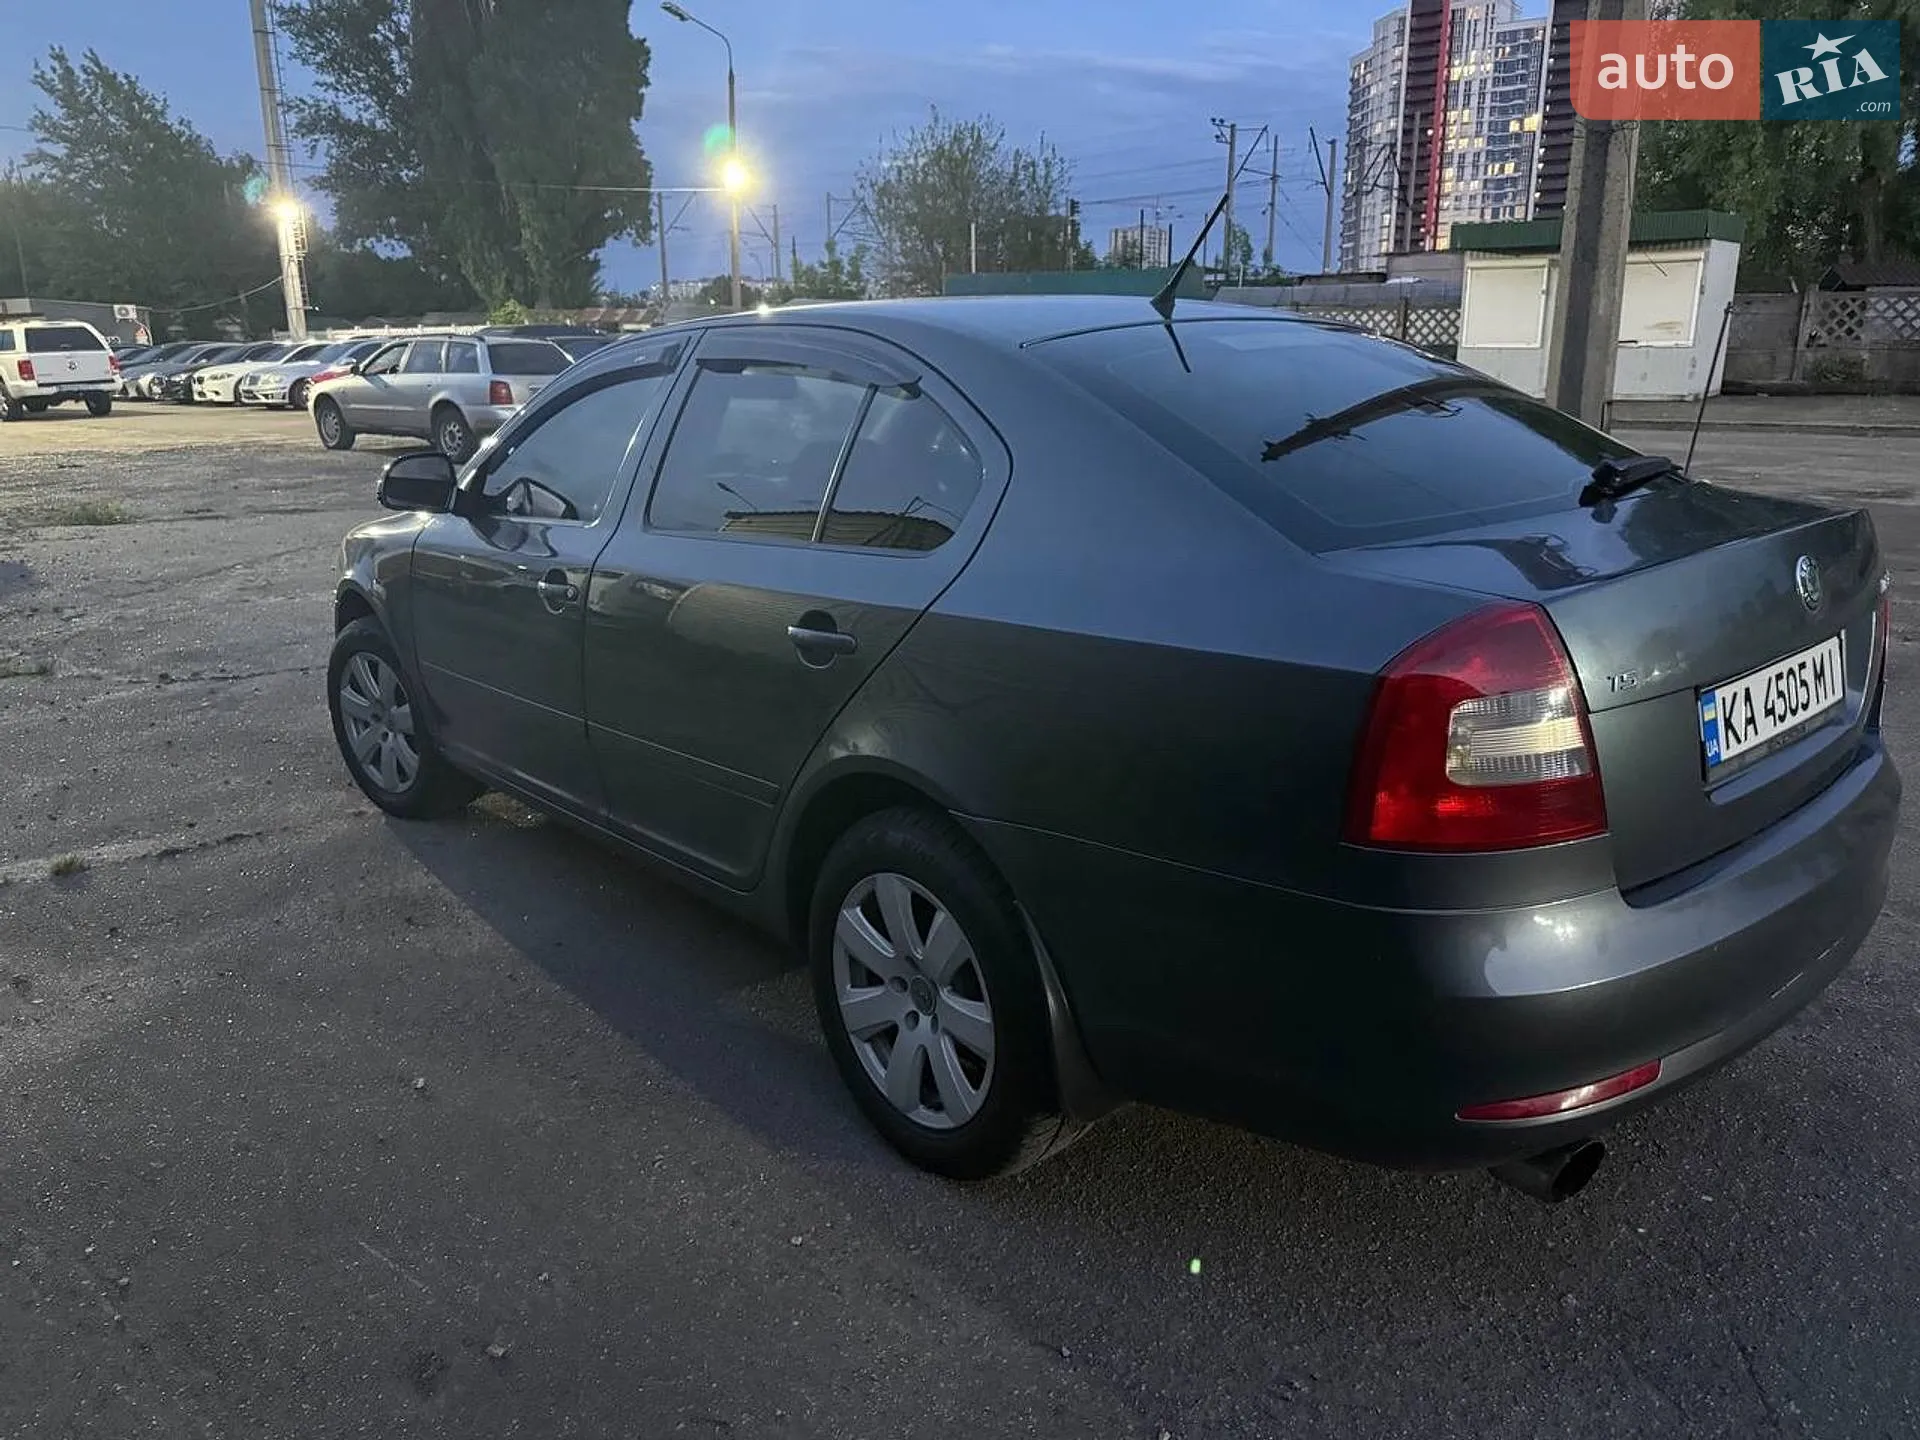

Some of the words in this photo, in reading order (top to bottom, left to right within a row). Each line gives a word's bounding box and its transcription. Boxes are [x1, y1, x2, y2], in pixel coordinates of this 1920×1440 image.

[1722, 686, 1758, 750] KA
[1763, 661, 1810, 728] 4505
[1812, 648, 1836, 705] MI
[1706, 738, 1719, 757] UA
